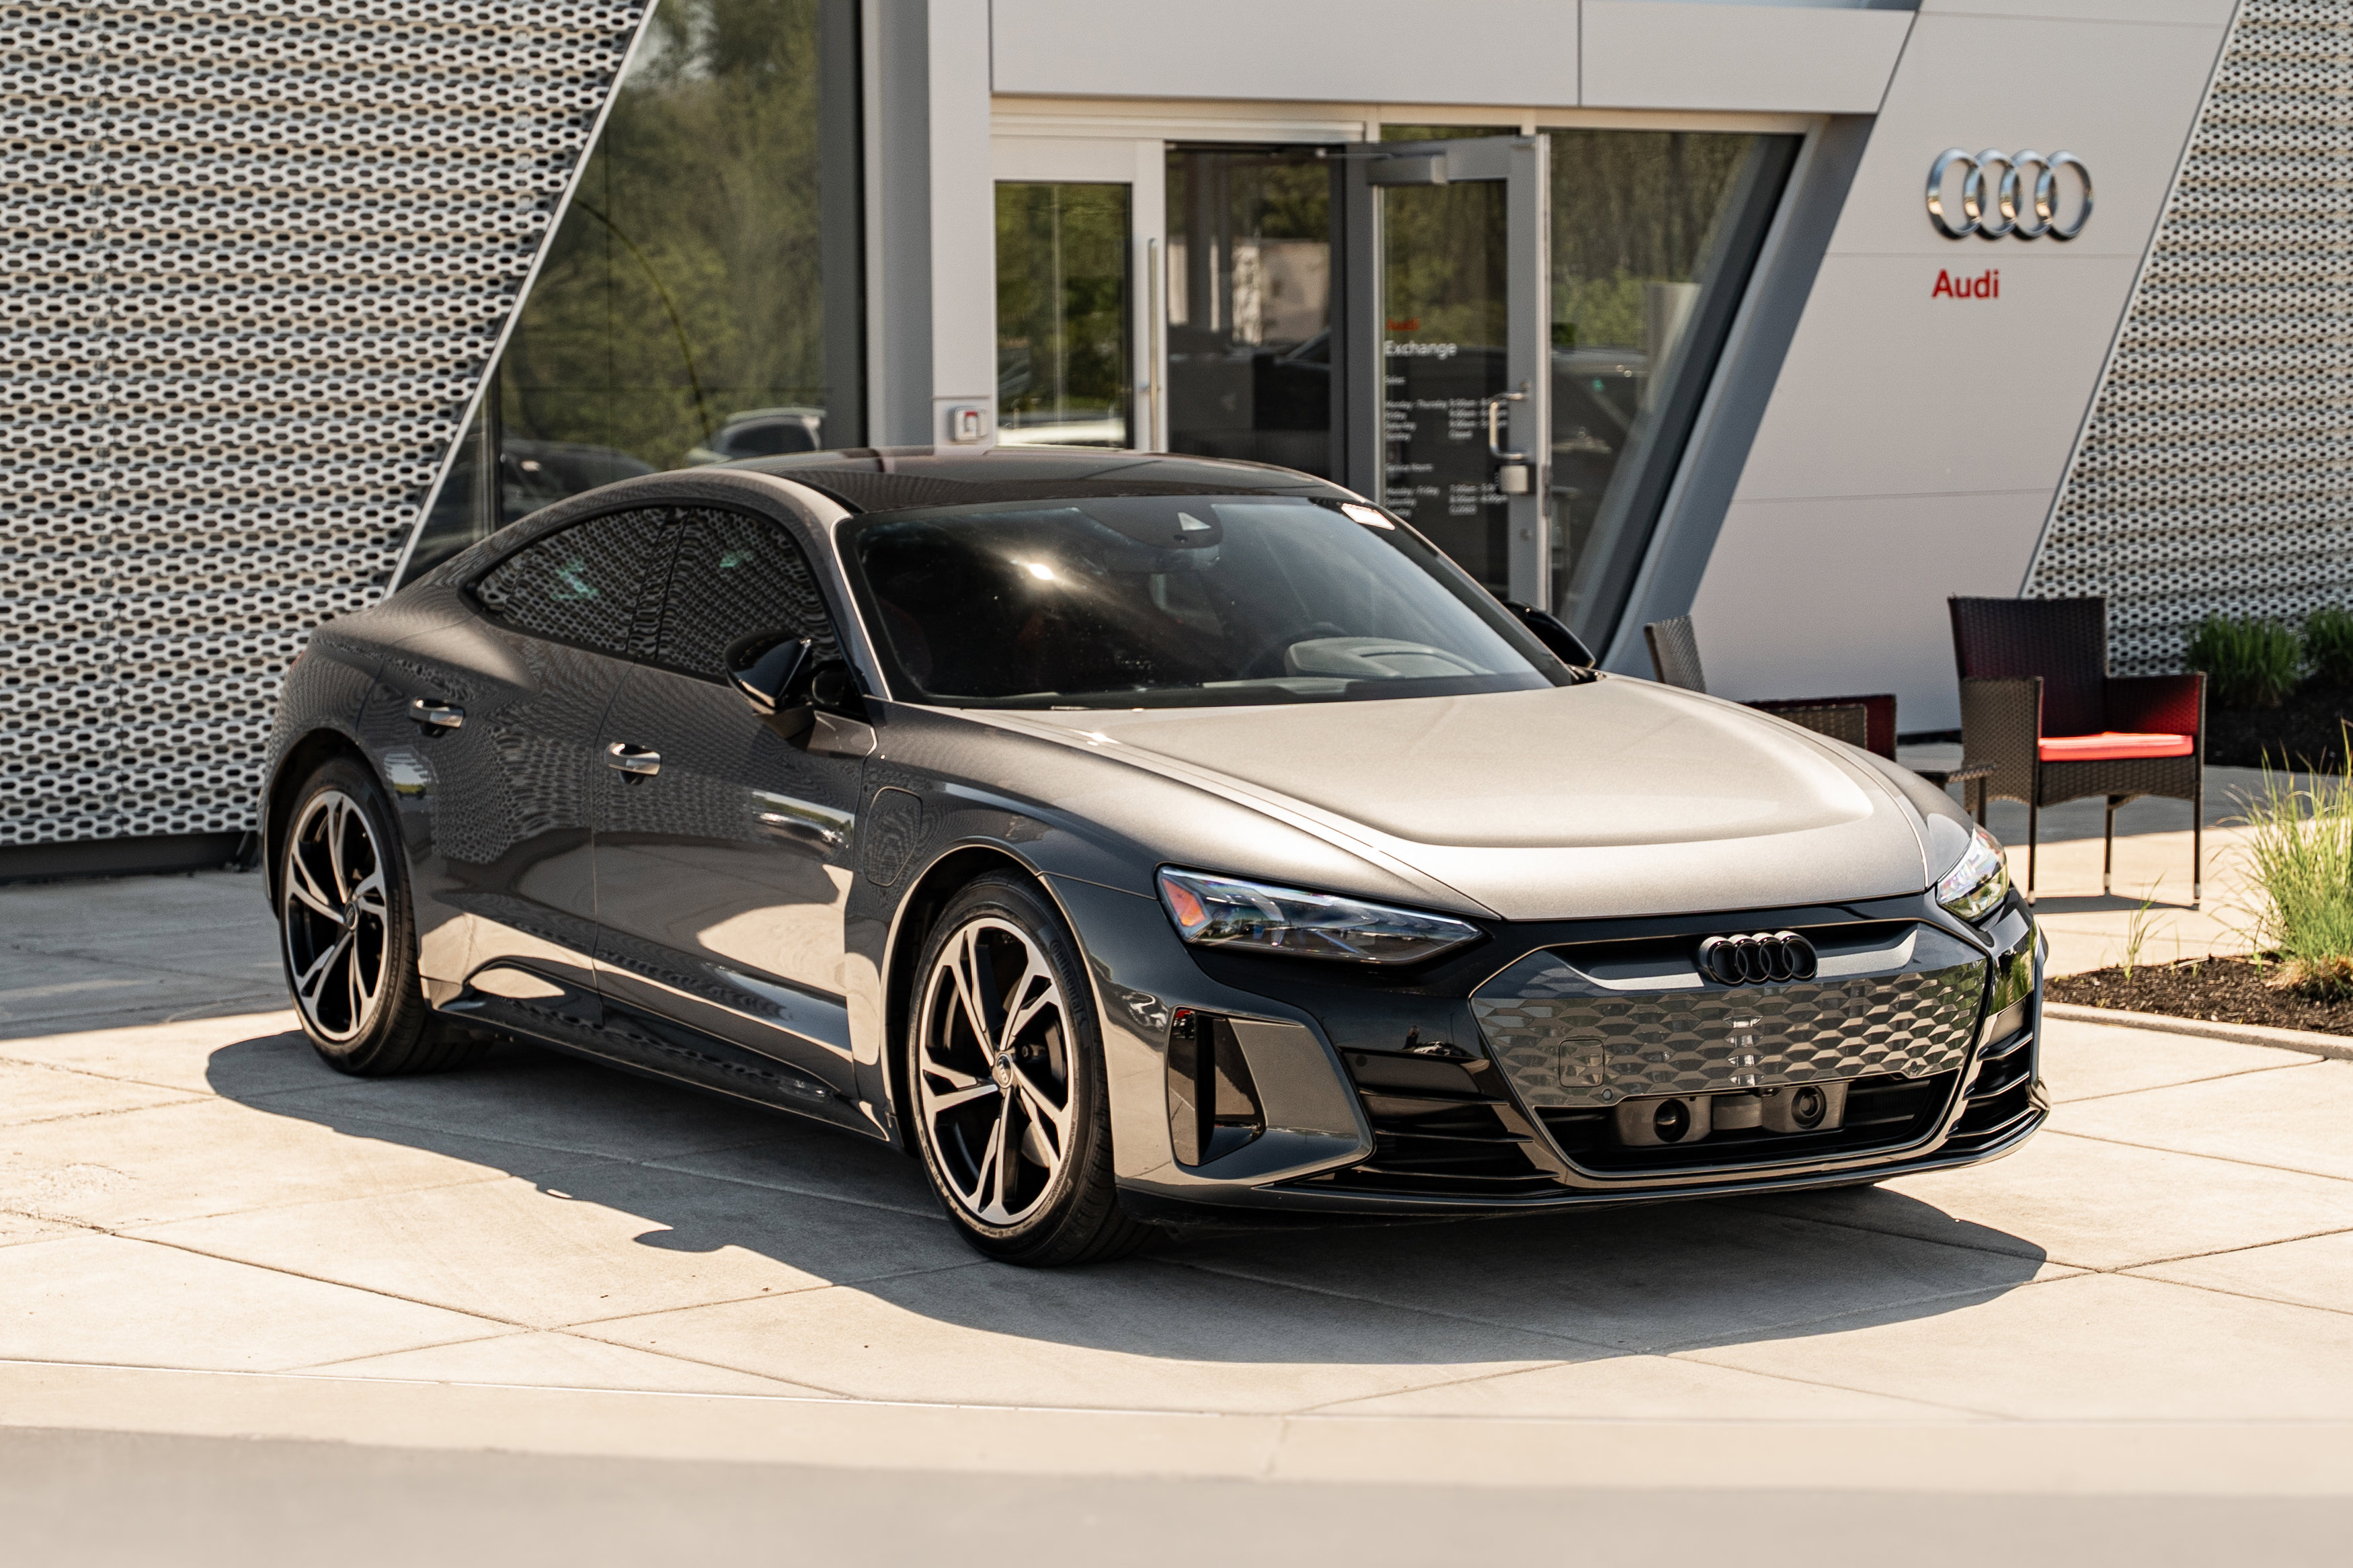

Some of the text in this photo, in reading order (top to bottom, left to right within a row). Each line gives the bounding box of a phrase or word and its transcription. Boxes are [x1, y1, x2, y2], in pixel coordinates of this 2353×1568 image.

[1931, 269, 1999, 298] Audi
[1385, 340, 1458, 360] Exchange
[1049, 939, 1084, 1014] Continental
